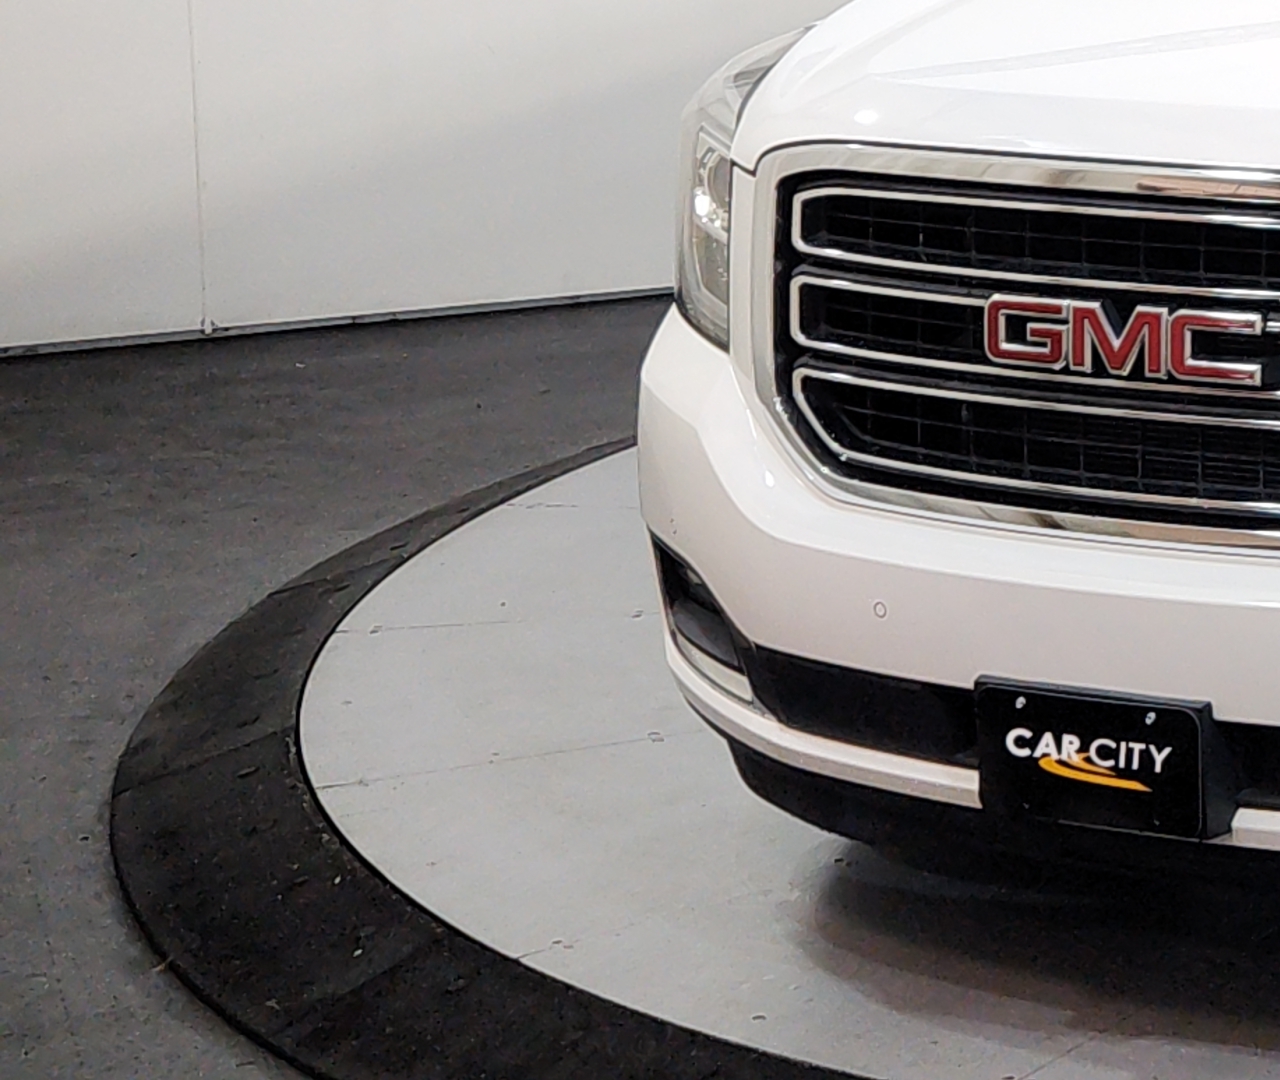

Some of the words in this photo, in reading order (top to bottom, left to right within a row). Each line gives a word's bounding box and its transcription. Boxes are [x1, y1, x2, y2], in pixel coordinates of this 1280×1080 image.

[984, 293, 1262, 387] GMC
[1005, 727, 1081, 762] CAR
[1089, 738, 1173, 774] CITY
